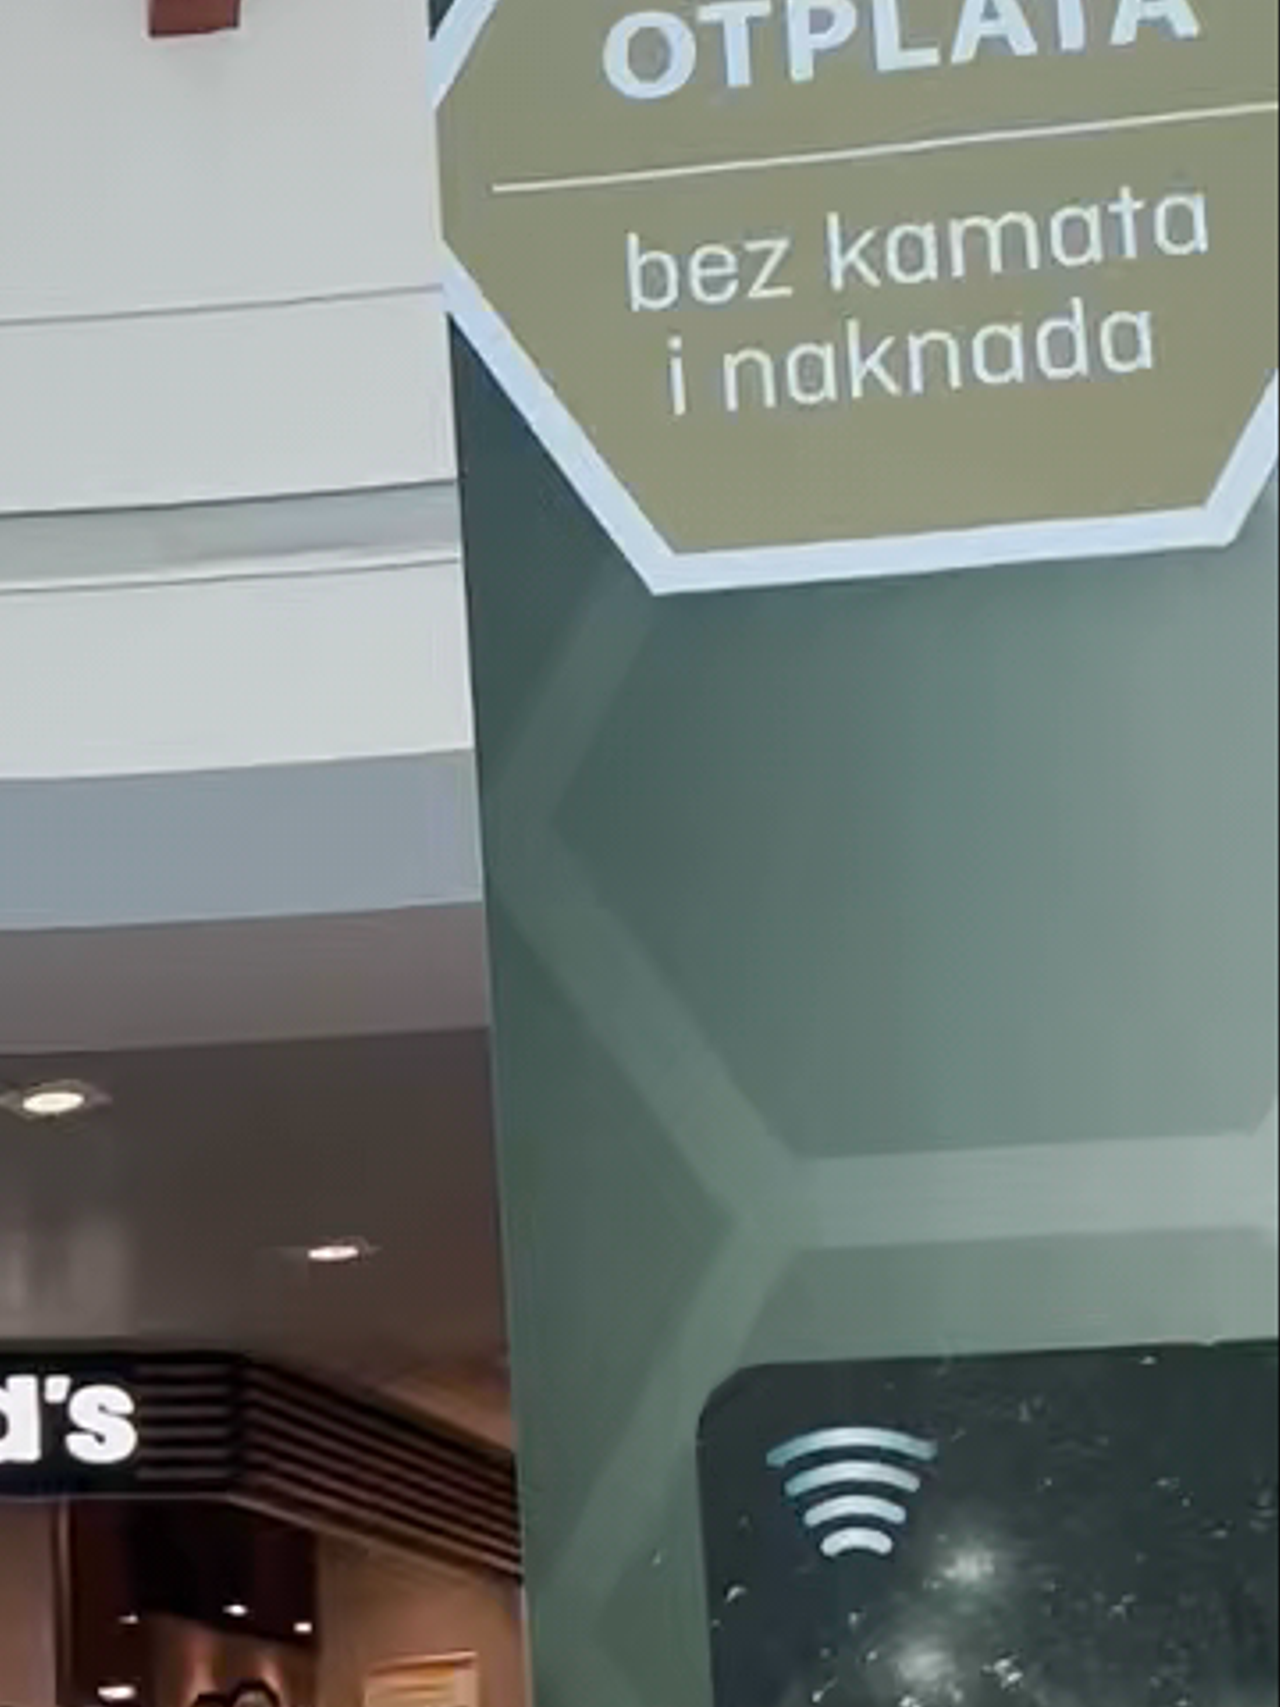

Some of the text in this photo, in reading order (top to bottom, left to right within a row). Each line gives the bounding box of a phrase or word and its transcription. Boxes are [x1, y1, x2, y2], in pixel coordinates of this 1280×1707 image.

[627, 185, 1210, 313] bez kamata
[667, 295, 1154, 416] i naknada
